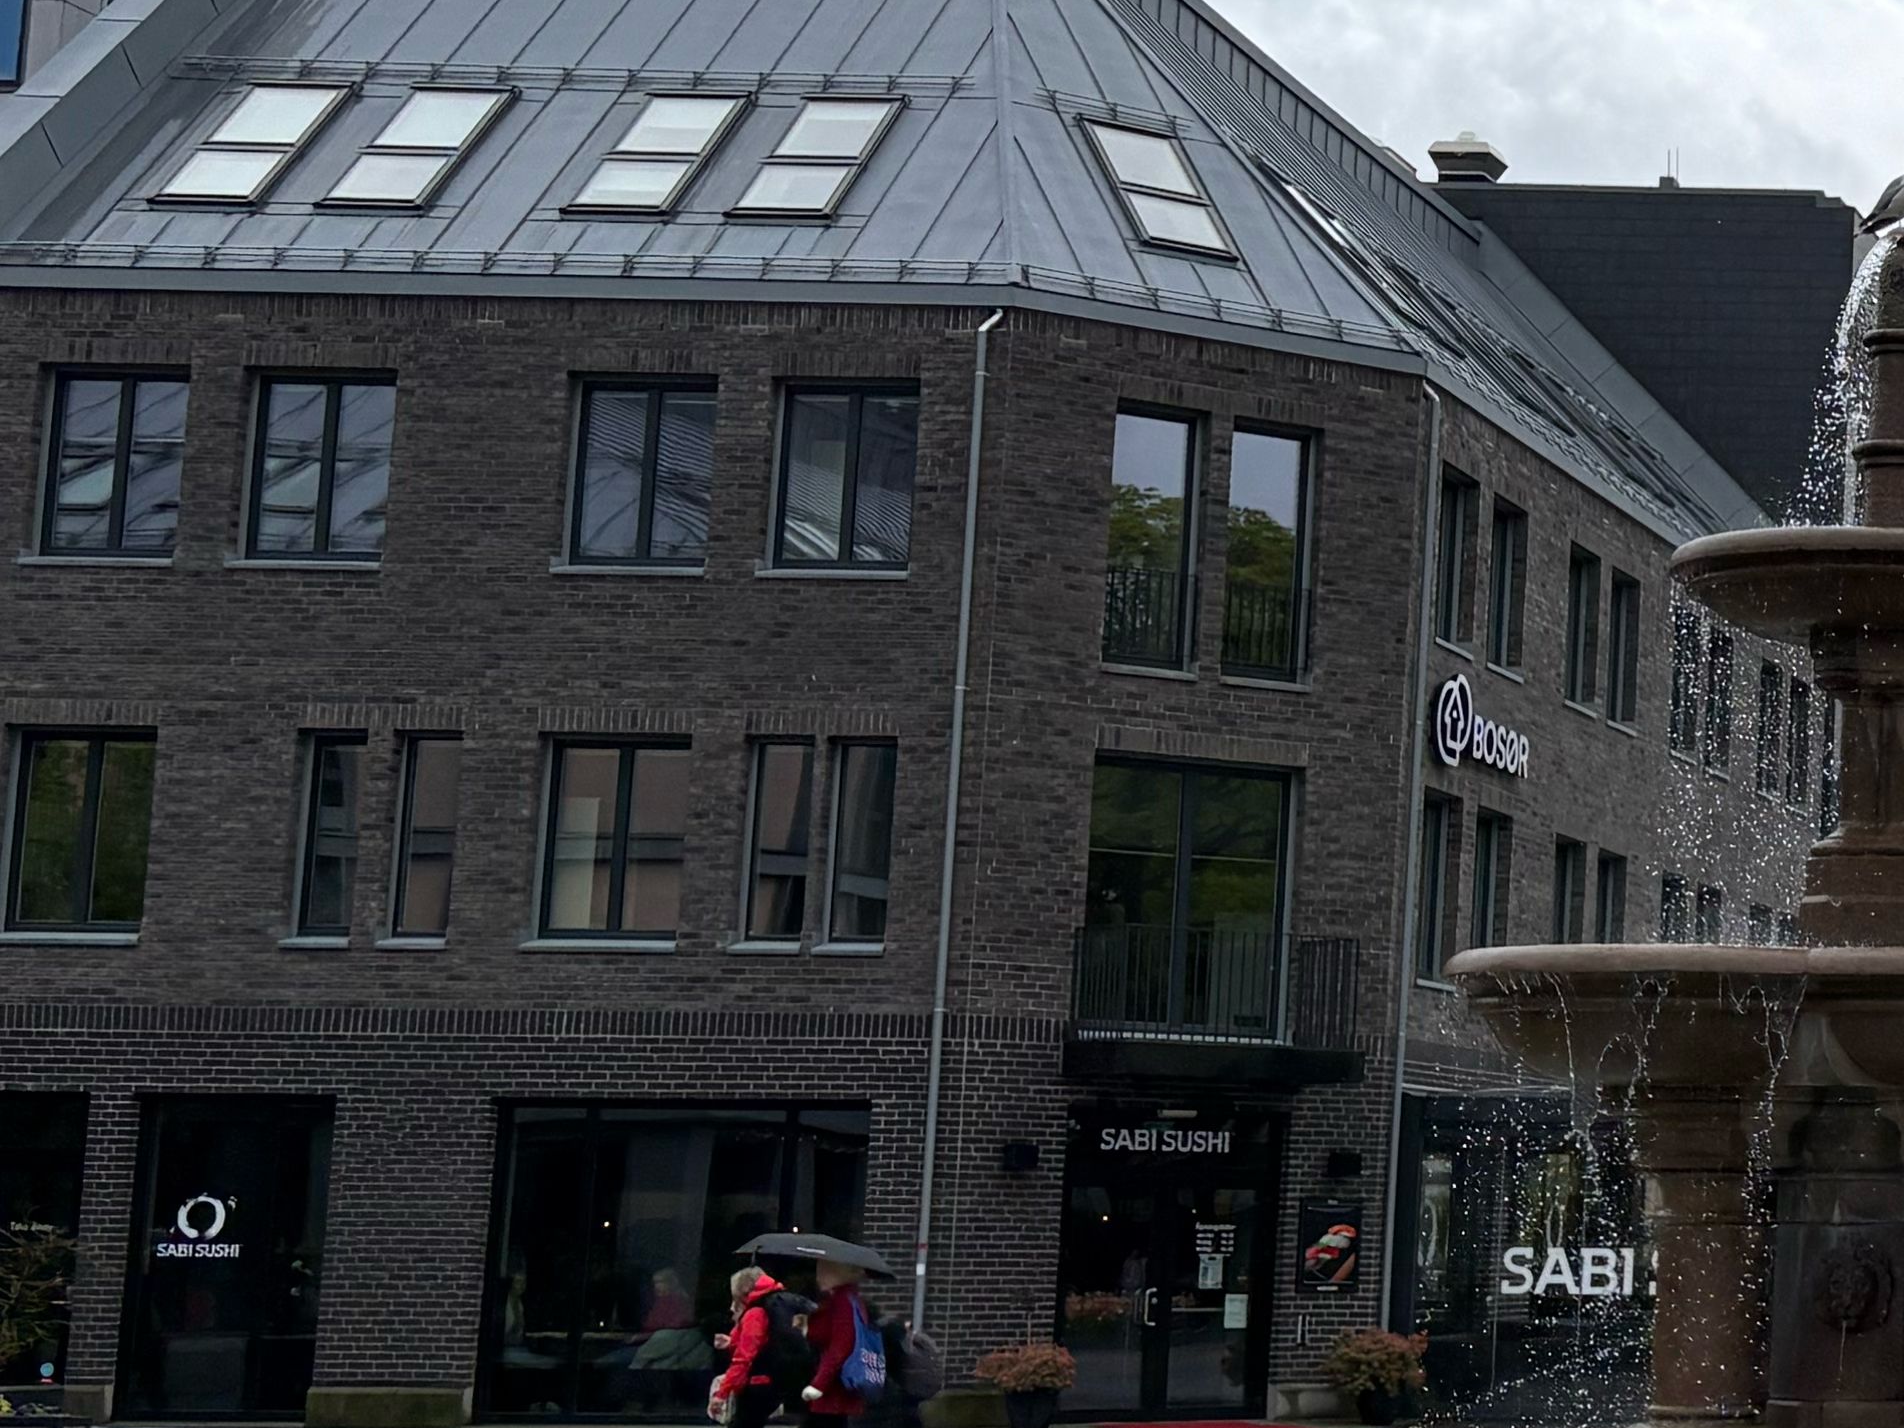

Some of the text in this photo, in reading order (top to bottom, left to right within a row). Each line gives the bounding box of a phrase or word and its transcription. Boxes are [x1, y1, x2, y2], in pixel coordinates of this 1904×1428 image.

[1473, 714, 1530, 779] BOSØR
[1100, 1128, 1230, 1154] SABI SUSHI
[156, 1243, 240, 1258] SABI SUSHI
[1500, 1246, 1635, 1296] SABI
